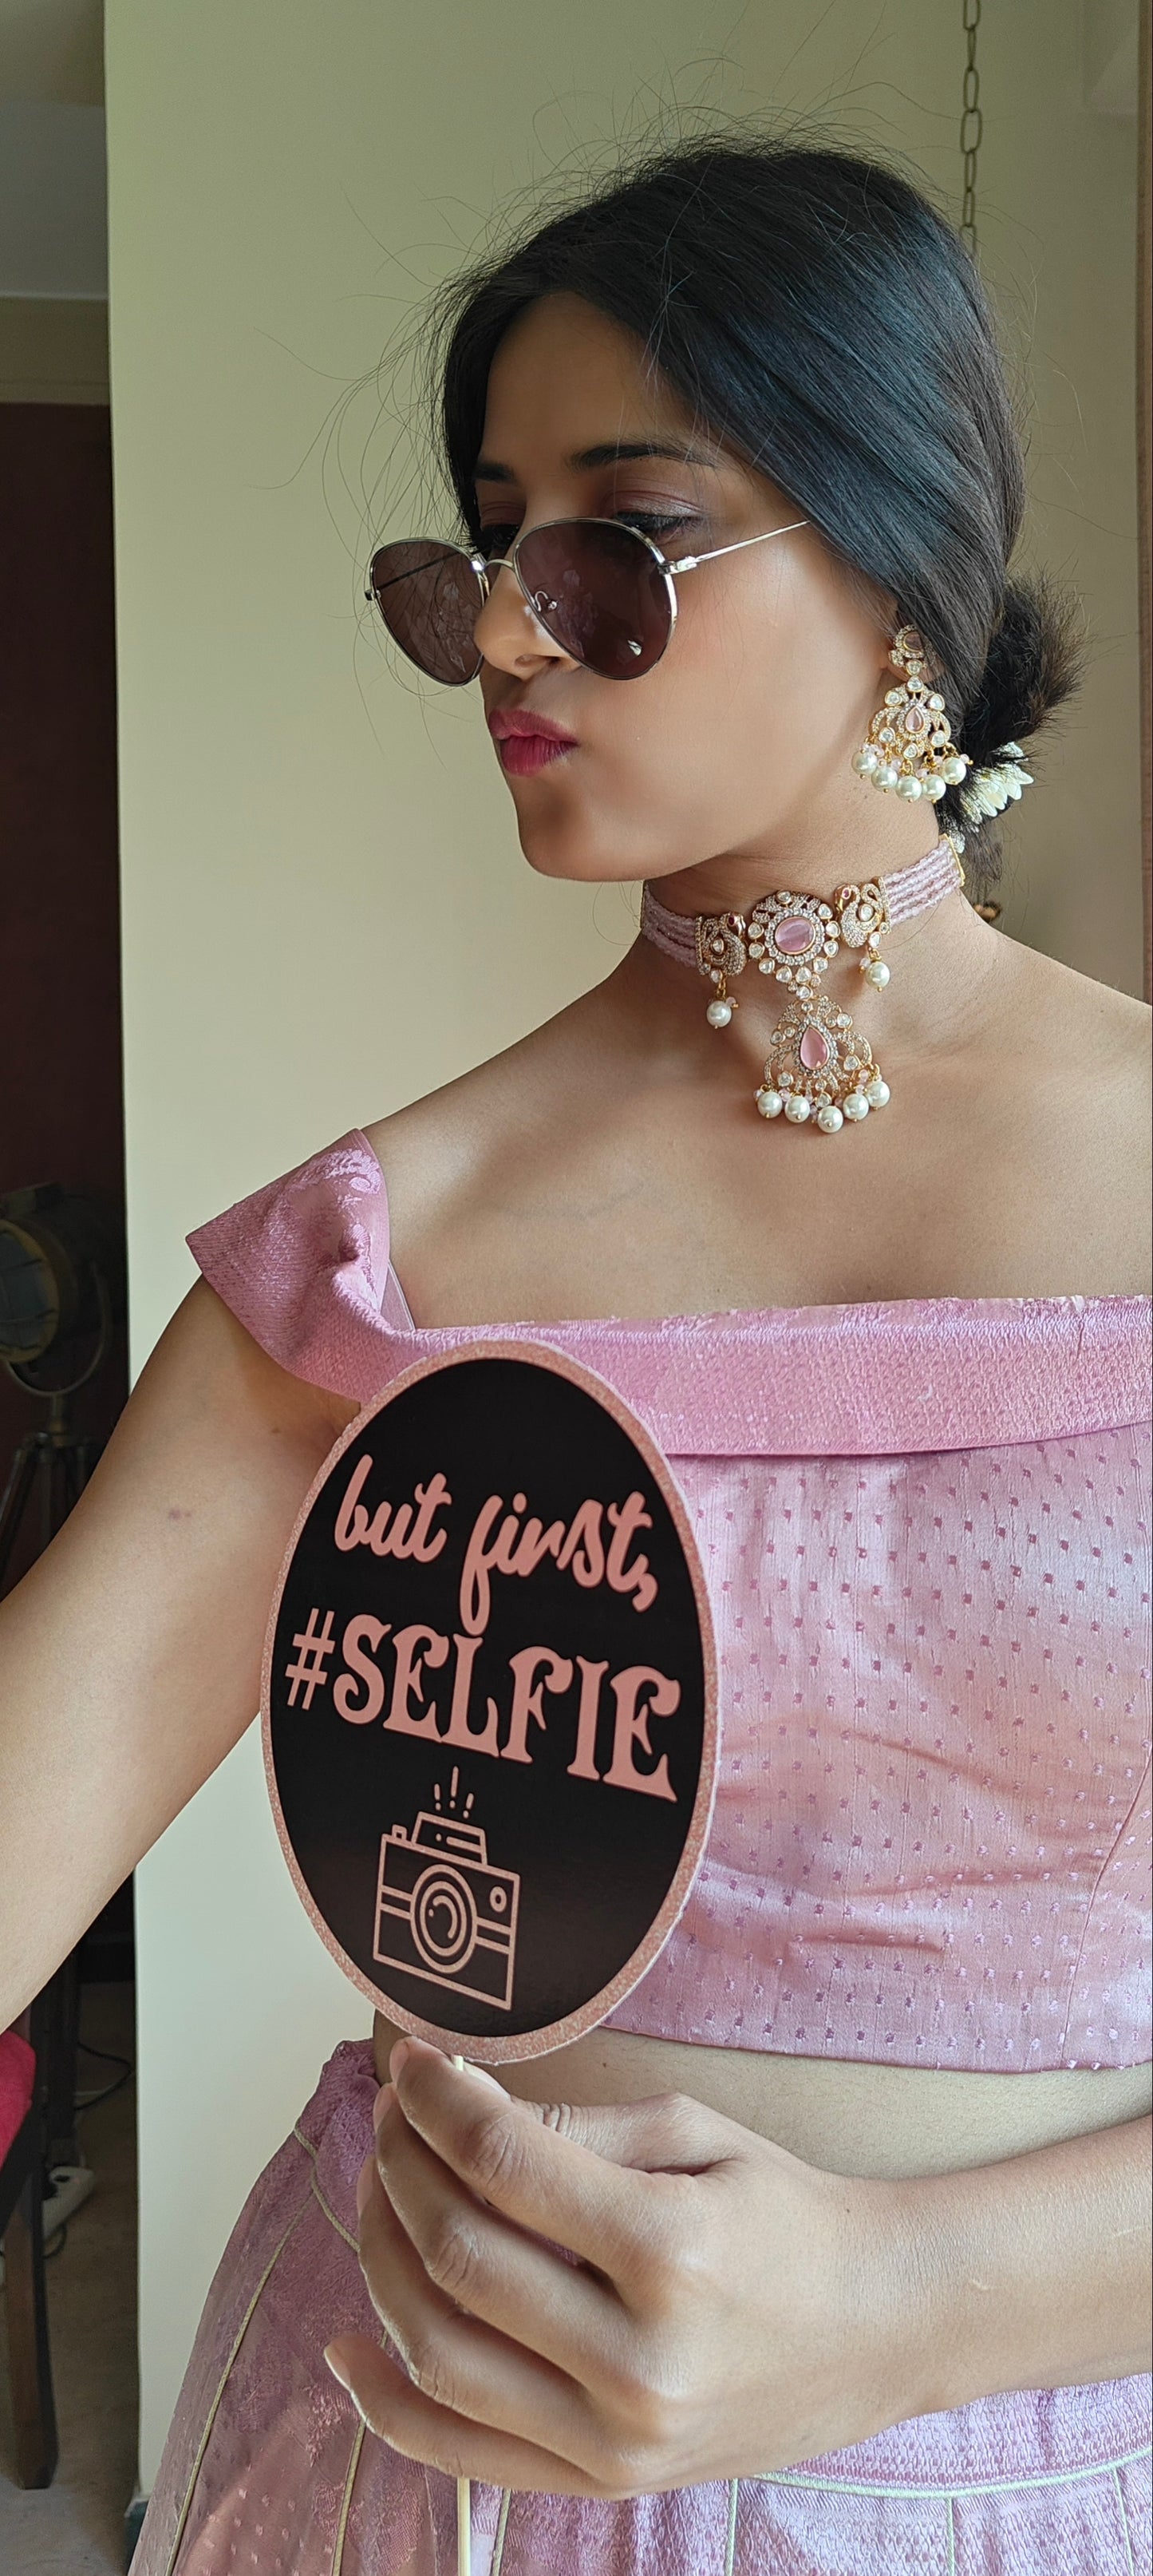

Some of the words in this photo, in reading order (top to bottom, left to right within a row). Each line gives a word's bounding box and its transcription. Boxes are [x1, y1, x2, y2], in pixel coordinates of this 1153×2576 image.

[334, 1454, 453, 1564] but
[459, 1490, 659, 1637] first,
[284, 1607, 681, 1802] #SELFIE
